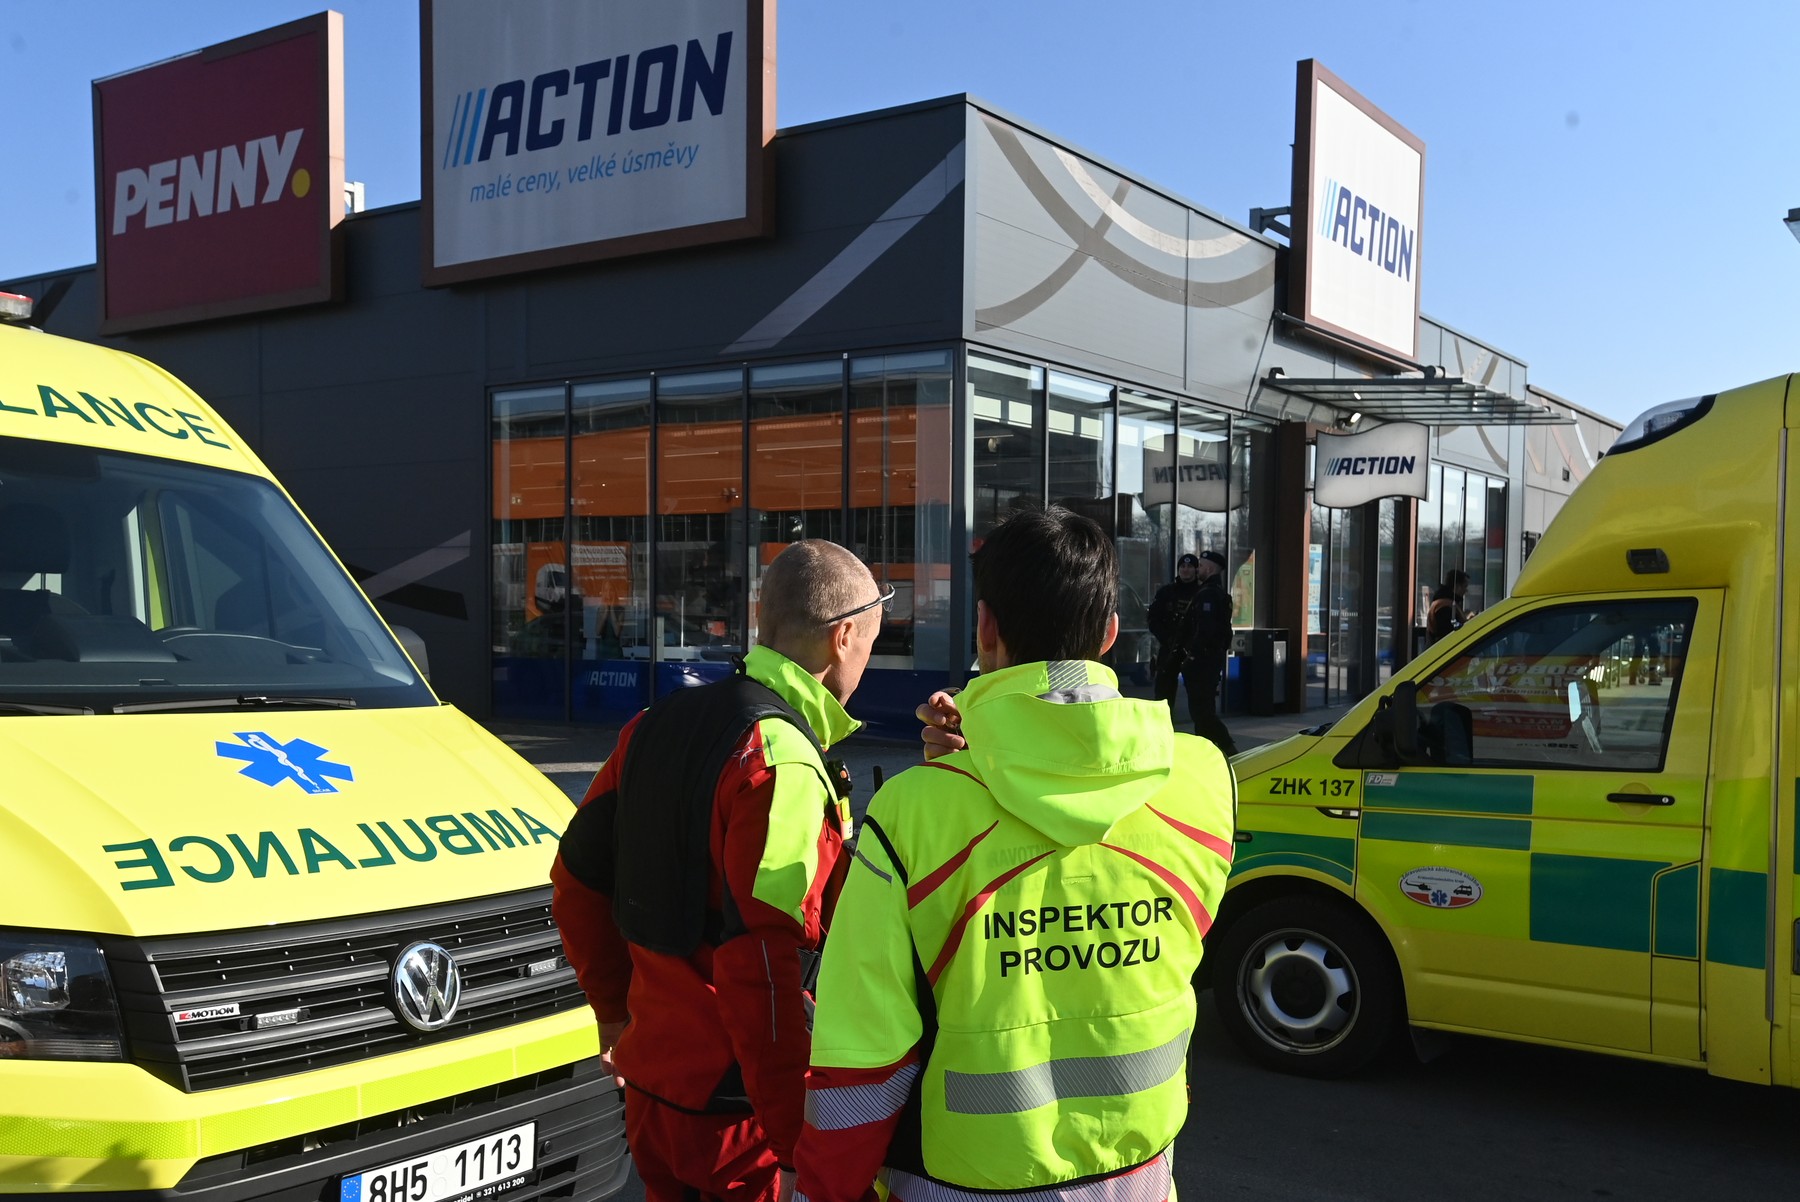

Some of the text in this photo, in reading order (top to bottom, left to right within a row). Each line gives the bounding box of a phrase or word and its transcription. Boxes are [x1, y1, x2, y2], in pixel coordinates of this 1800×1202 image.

[477, 31, 733, 162] ACTION
[470, 141, 700, 202] malé ceny, velké úsměvy
[1332, 185, 1414, 282] ACTION
[1335, 455, 1416, 477] ACTION
[589, 670, 637, 687] ACTION
[1269, 777, 1355, 797] ZHK 137
[1368, 775, 1382, 784] FD
[983, 896, 1173, 940] INSPEKTOR
[1000, 936, 1161, 978] PROVOZU
[369, 1134, 521, 1202] 8H5 1113
[483, 1187, 496, 1197] 321
[498, 1181, 511, 1192] 613
[512, 1176, 525, 1187] 200
